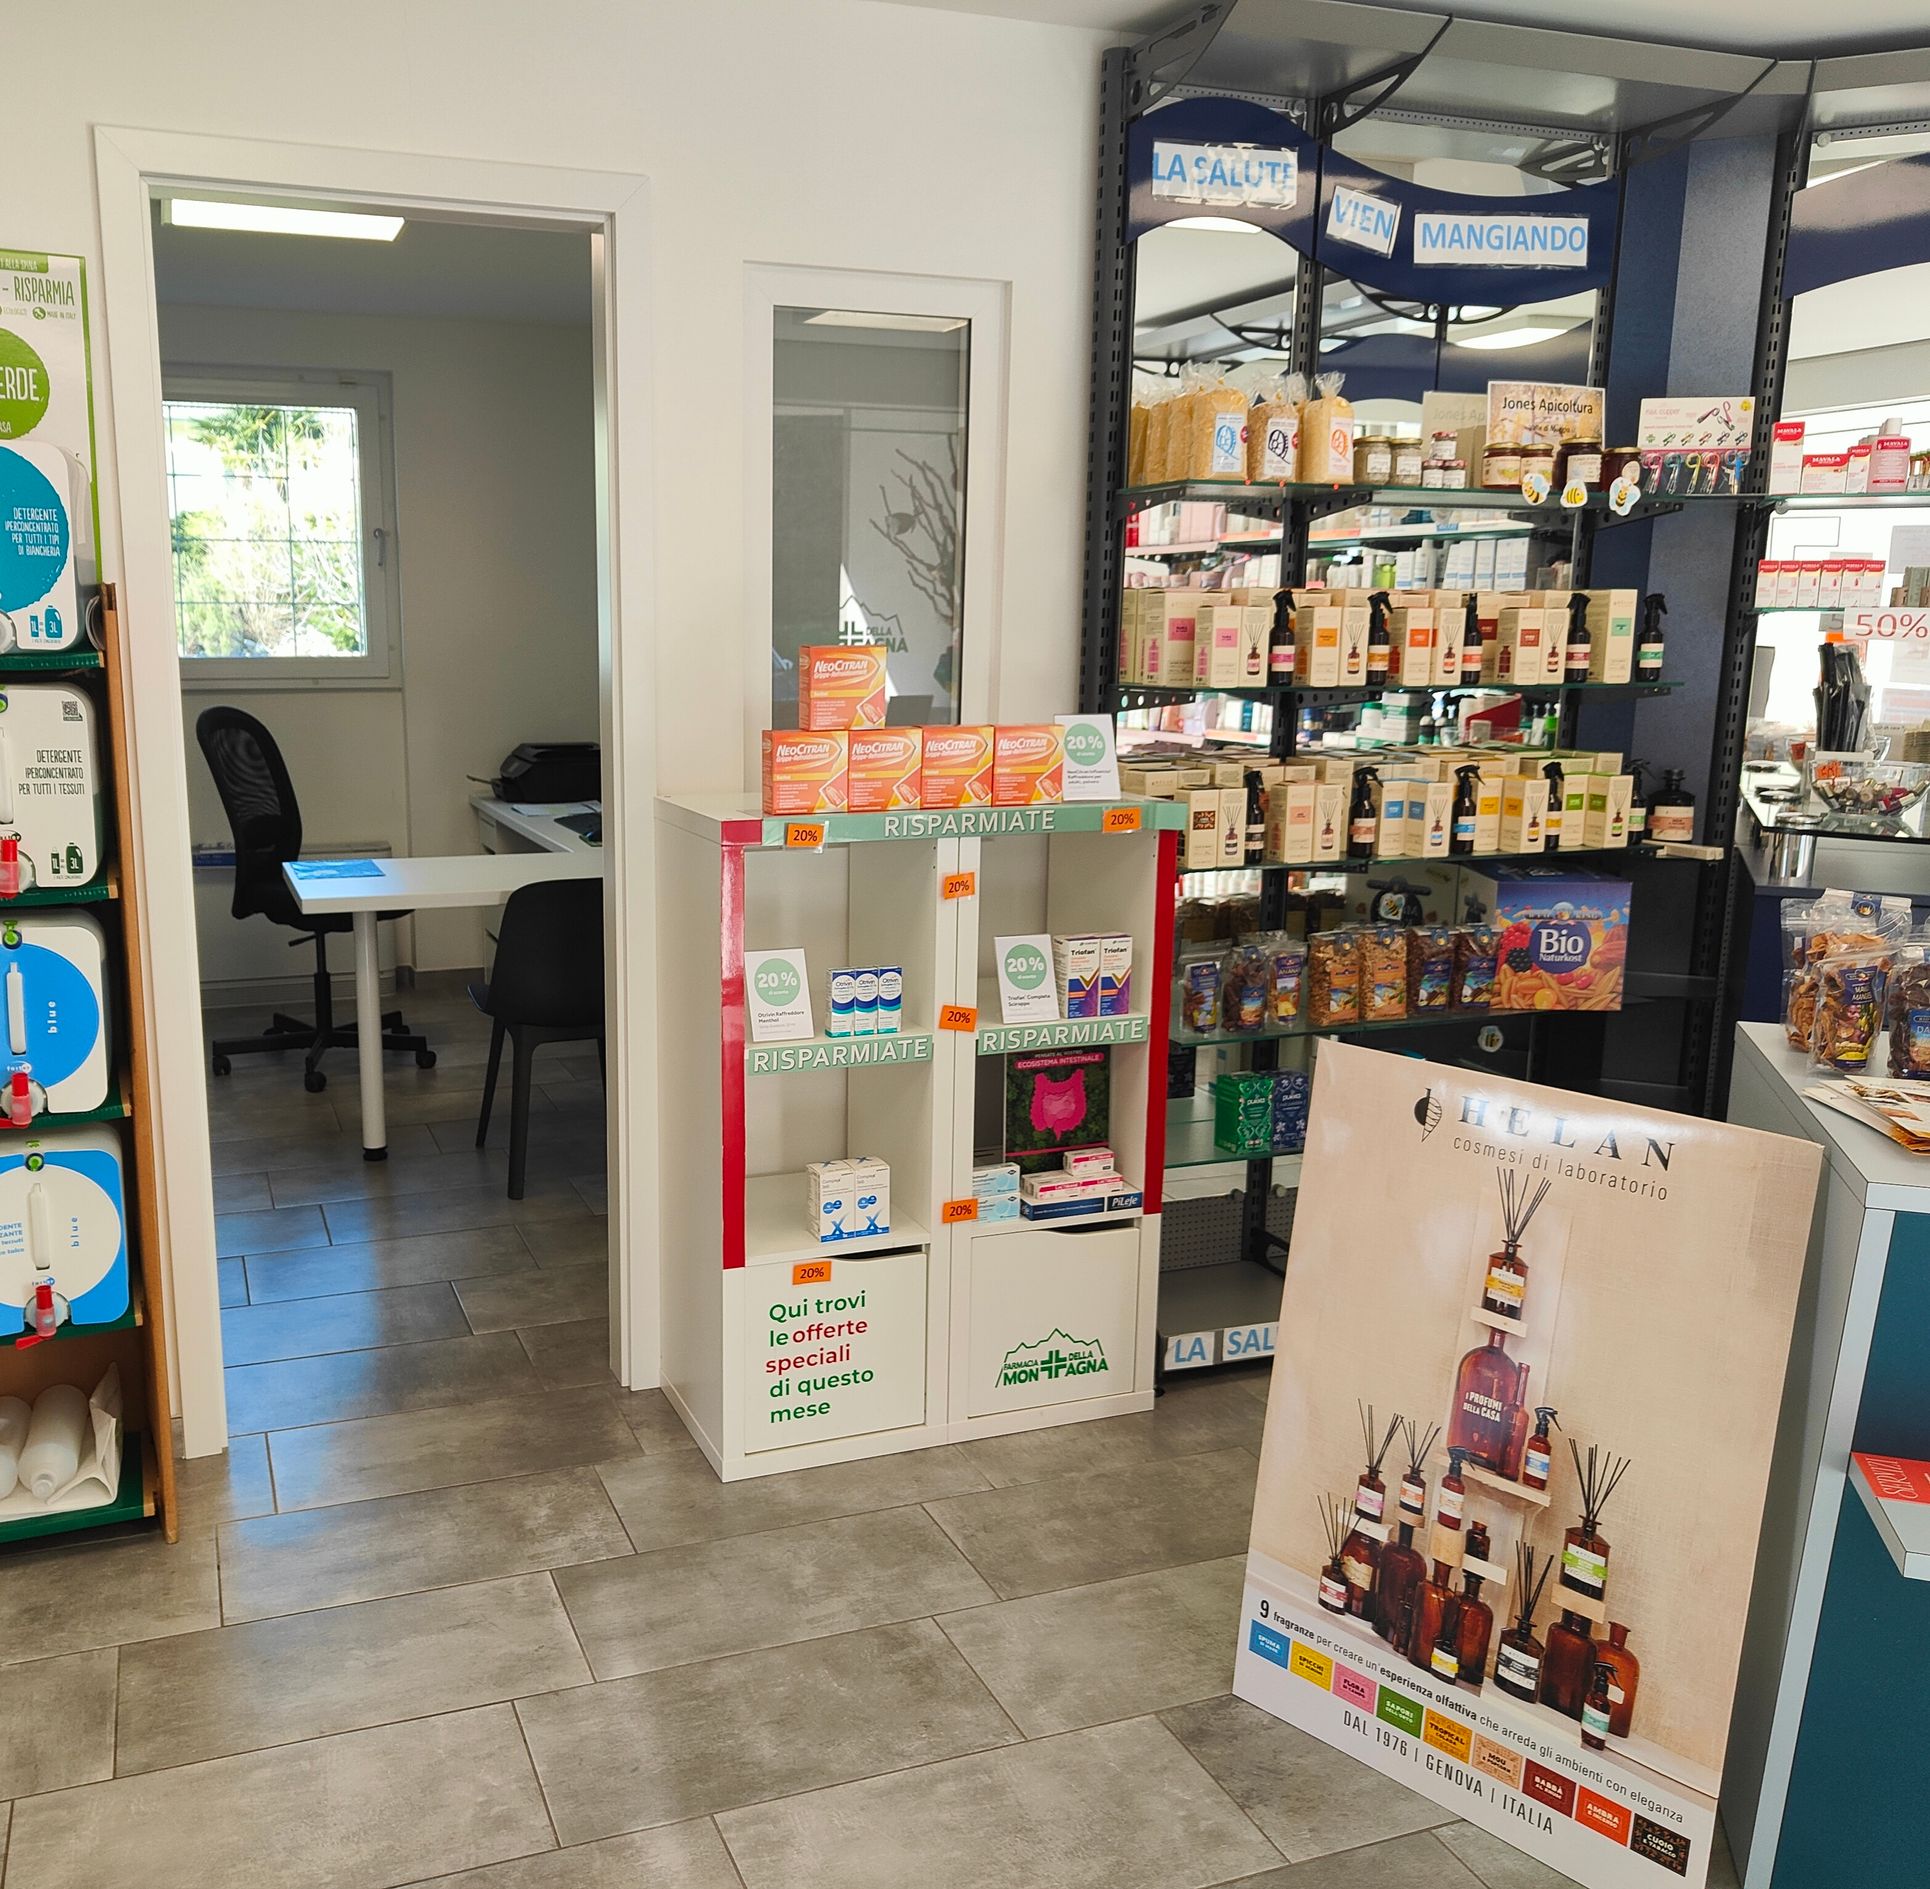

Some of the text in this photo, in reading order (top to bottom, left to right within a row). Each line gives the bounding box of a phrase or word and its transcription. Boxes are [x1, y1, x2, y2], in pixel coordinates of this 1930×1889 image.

[1152, 152, 1295, 193] LA SALUTE
[1333, 194, 1393, 241] VIEN
[1422, 221, 1587, 252] MANGIANDO
[14, 275, 75, 306] RISPARMIA
[1502, 396, 1593, 415] Jones Apicoltura
[13, 507, 58, 521] DETERGENTE
[5, 520, 59, 533] IPERCONCENTRATO
[12, 533, 23, 544] PER
[25, 533, 43, 544] TUTTI
[26, 545, 60, 557] BIANCHERIA
[49, 620, 58, 634] 3L
[866, 626, 892, 637] DELLA
[1855, 613, 1928, 639] 50%
[36, 749, 82, 763] DETERGENTE
[25, 767, 84, 780] IPERCONCENTRATO
[18, 783, 31, 795] PER
[33, 783, 52, 795] TUTTI
[59, 783, 85, 795] TESSUTI
[883, 809, 1055, 838] RISPARMIATE
[1111, 813, 1135, 825] 20%
[793, 829, 818, 842] 20%
[70, 857, 79, 870] 3L
[948, 880, 970, 894] 20%
[1539, 929, 1584, 954] Bio
[1539, 953, 1582, 963] Naturkost
[47, 1001, 59, 1034] blue
[947, 1011, 971, 1024] 20%
[983, 1019, 1144, 1052] RISPARMIATE
[753, 1038, 929, 1073] RISPARMIATE
[1018, 1054, 1100, 1069] ECOSISTEMA INTESTINALE
[1458, 1095, 1676, 1172] HELAN
[1453, 1135, 1668, 1201] cosmesi di laboratorio
[949, 1204, 972, 1217] 20%
[70, 1217, 80, 1248] blue
[800, 1267, 824, 1279] 20%
[769, 1290, 866, 1323] Qui trovi
[769, 1320, 868, 1347] le offerte
[1175, 1327, 1278, 1363] LA SAL
[765, 1343, 851, 1375] speciali
[1003, 1350, 1094, 1371] FARMACIA DELLA
[769, 1369, 874, 1398] di questo
[1469, 1391, 1503, 1411] PROFUMI
[770, 1402, 831, 1424] mese
[1480, 1407, 1501, 1422] CASA
[1299, 1655, 1324, 1672] SPICCHI
[1343, 1678, 1365, 1694] FLORA
[1260, 1599, 1270, 1618] 9
[1273, 1611, 1315, 1639] fragranze
[1316, 1634, 1332, 1648] per
[1333, 1643, 1364, 1664] creare
[1435, 1695, 1477, 1721] olfattiva
[1479, 1710, 1499, 1732] che
[1501, 1726, 1537, 1751] arreda
[1539, 1745, 1553, 1761] gli
[1555, 1752, 1604, 1784] ambienti
[1606, 1777, 1627, 1796] con
[1630, 1791, 1684, 1824] eleganza
[1386, 1700, 1414, 1719] SAPORI
[1429, 1722, 1465, 1745] TROPICAL
[1488, 1752, 1506, 1766] MOU
[1343, 1710, 1553, 1835] DAL 1976 GENOVA ITALIA
[1586, 1803, 1619, 1824] AMBRA
[1646, 1833, 1674, 1851] CUOIO
[1649, 1841, 1677, 1858] TABACCO
